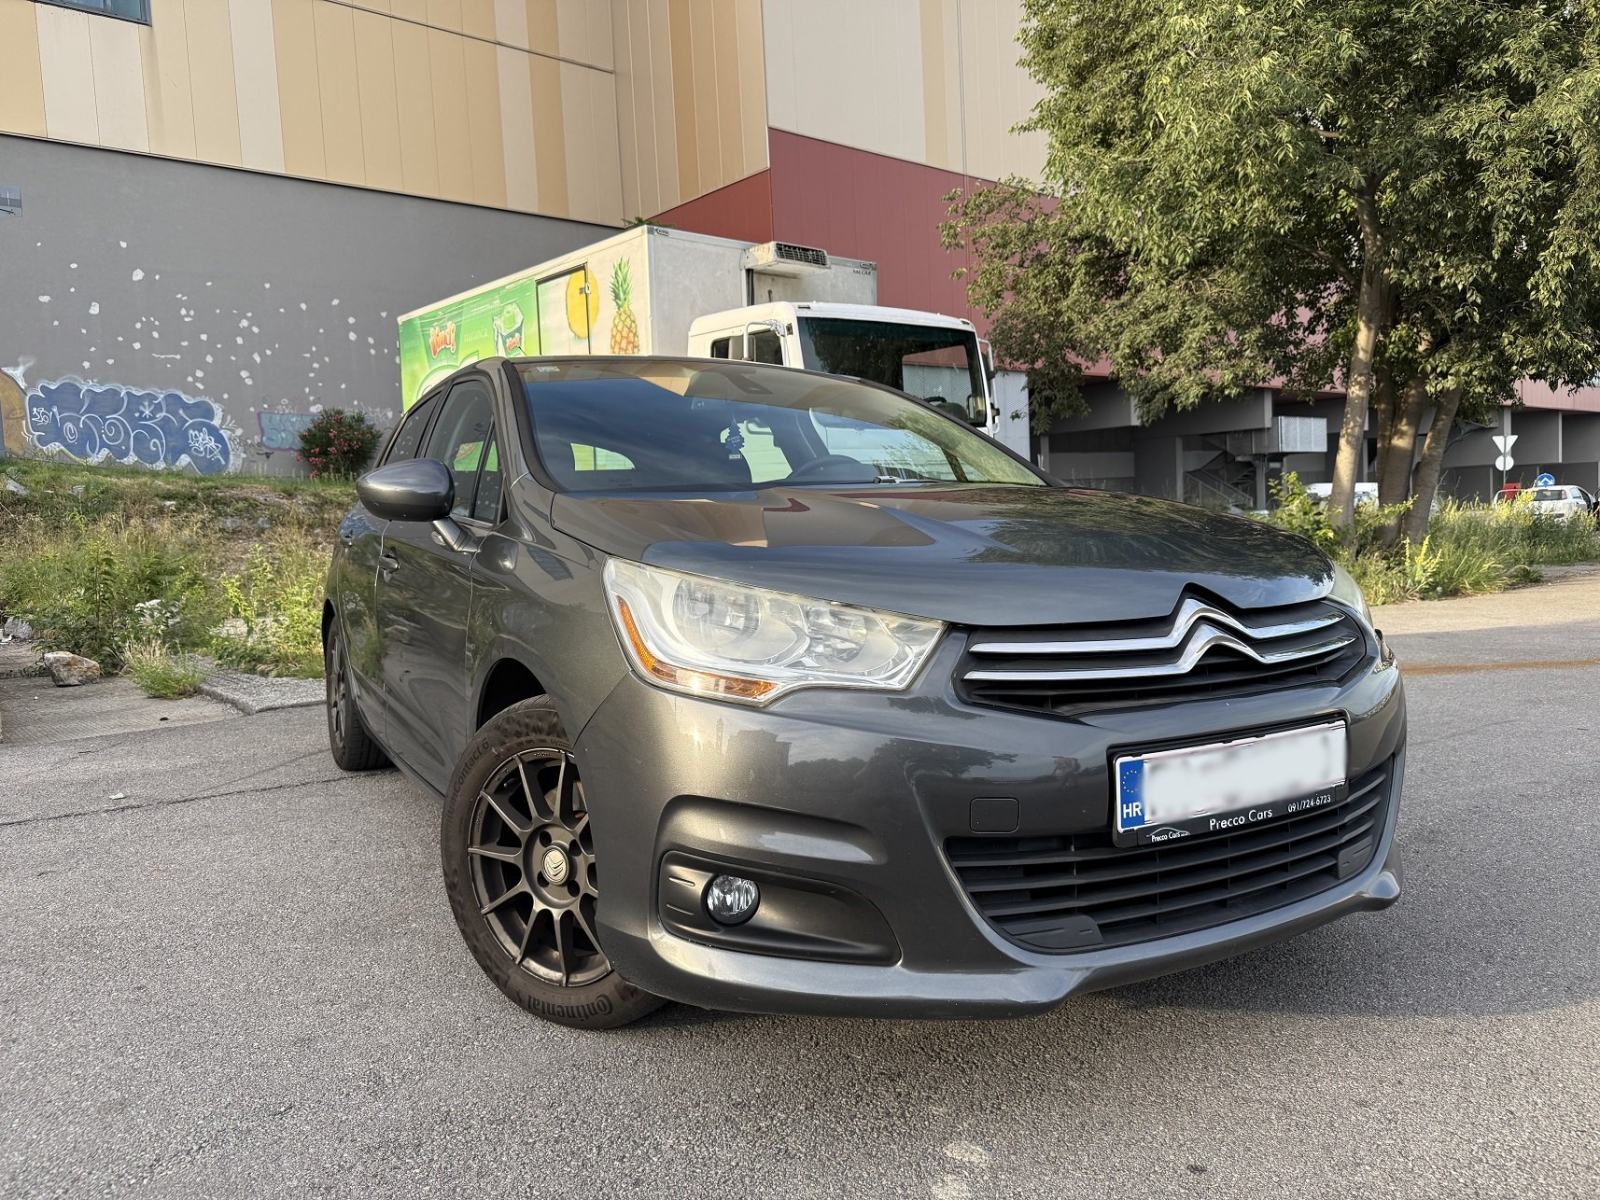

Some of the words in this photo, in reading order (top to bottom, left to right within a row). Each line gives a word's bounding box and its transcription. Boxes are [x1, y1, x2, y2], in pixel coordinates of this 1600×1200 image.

[1122, 803, 1142, 818] HR
[1209, 816, 1245, 831] Precco
[1248, 808, 1273, 822] Cars
[527, 995, 614, 1020] Continental
